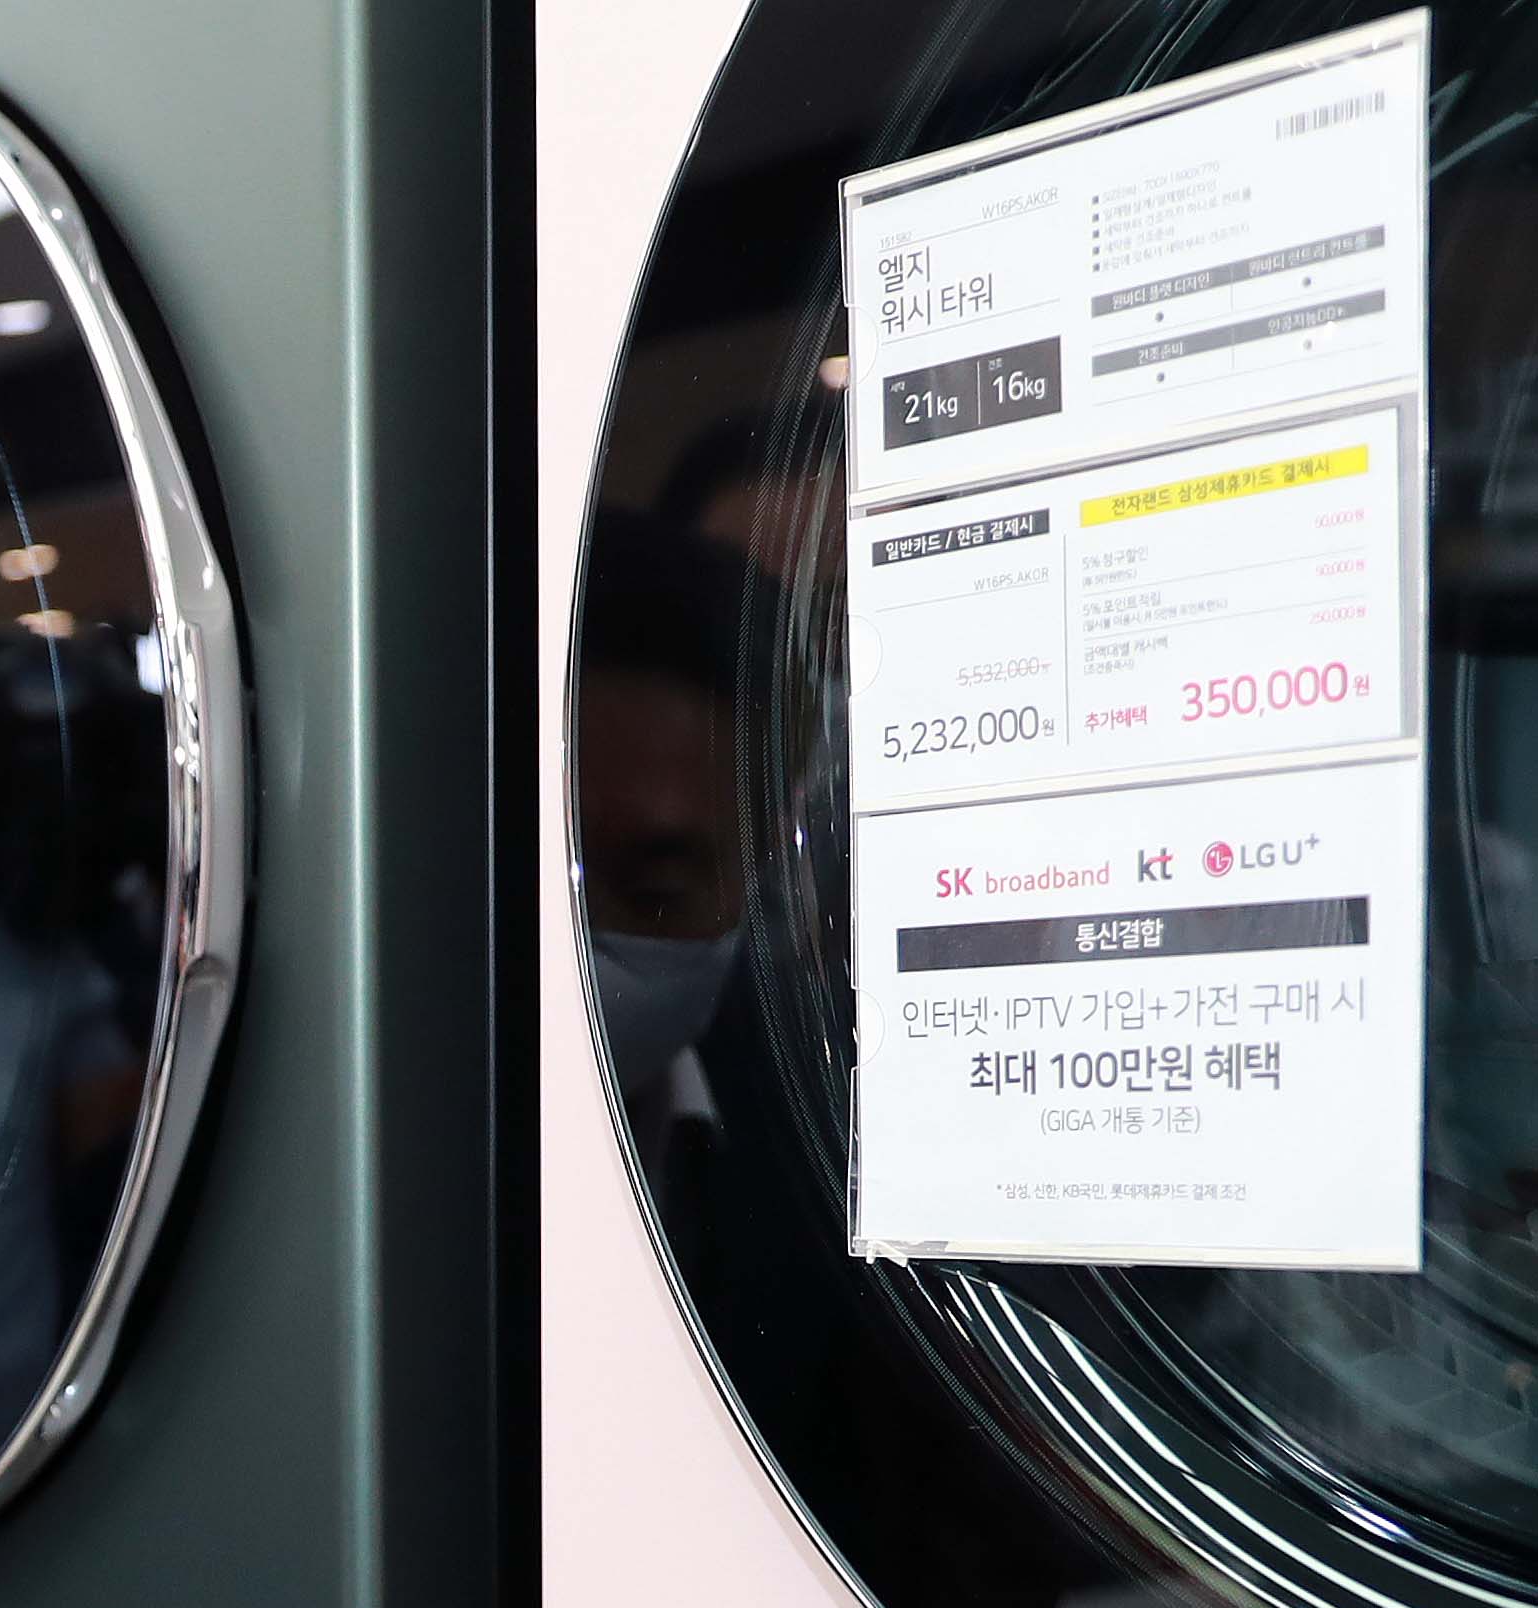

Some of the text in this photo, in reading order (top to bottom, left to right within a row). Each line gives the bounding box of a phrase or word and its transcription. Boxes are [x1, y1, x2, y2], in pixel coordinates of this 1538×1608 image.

[878, 245, 931, 294] 엘지
[880, 272, 994, 335] 워시 타워
[992, 371, 1046, 405] 16kg
[904, 390, 959, 425] 21kg
[1111, 488, 1172, 517] 전자랜드
[1280, 455, 1330, 484] 결제시
[885, 534, 942, 561] 일반카드
[957, 527, 985, 547] 현금
[990, 514, 1034, 541] 결제시
[1084, 704, 1148, 733] 추가혜택
[935, 861, 1111, 899] SK broadband
[1137, 847, 1174, 882] kt
[1075, 917, 1165, 953] 통신결합
[1080, 983, 1239, 1032] 가입+가전
[1248, 979, 1321, 1026] 구매
[1330, 976, 1366, 1022] 시
[969, 1041, 1283, 1096] 최대 100만원 혜택
[1040, 1105, 1202, 1136] (GIGA 개통 기준)
